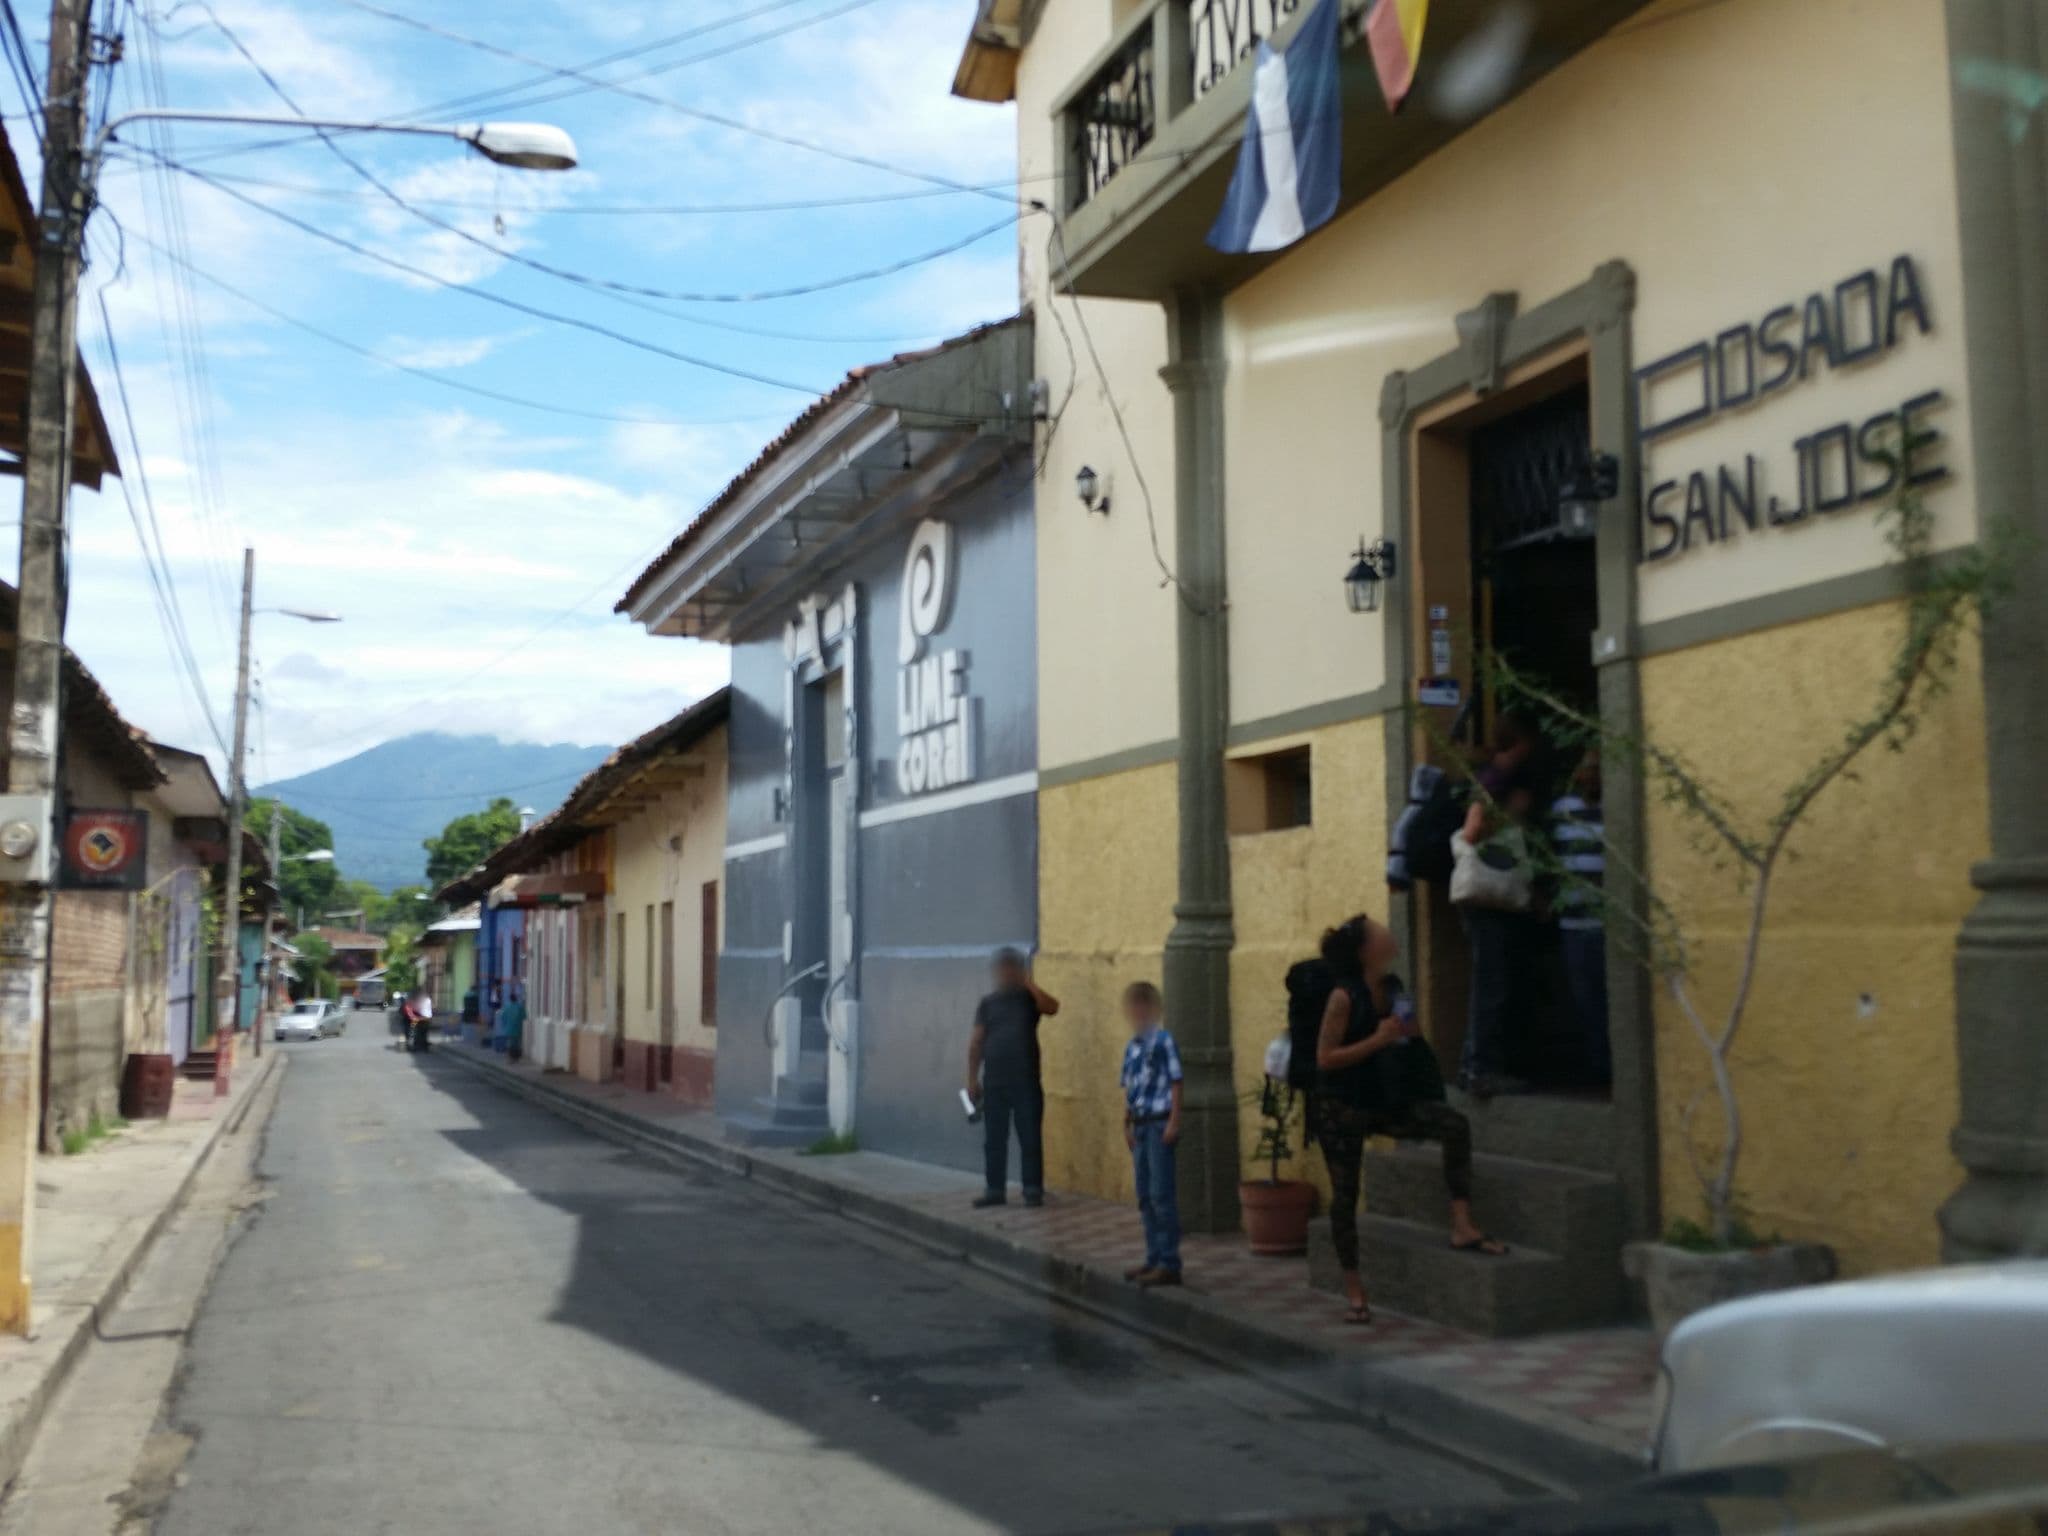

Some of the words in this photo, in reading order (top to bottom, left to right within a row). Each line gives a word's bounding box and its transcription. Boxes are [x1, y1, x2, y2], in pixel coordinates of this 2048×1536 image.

[1633, 254, 1932, 563] POSADA
[1647, 453, 1756, 561] SAN
[1768, 389, 1947, 525] JOSE
